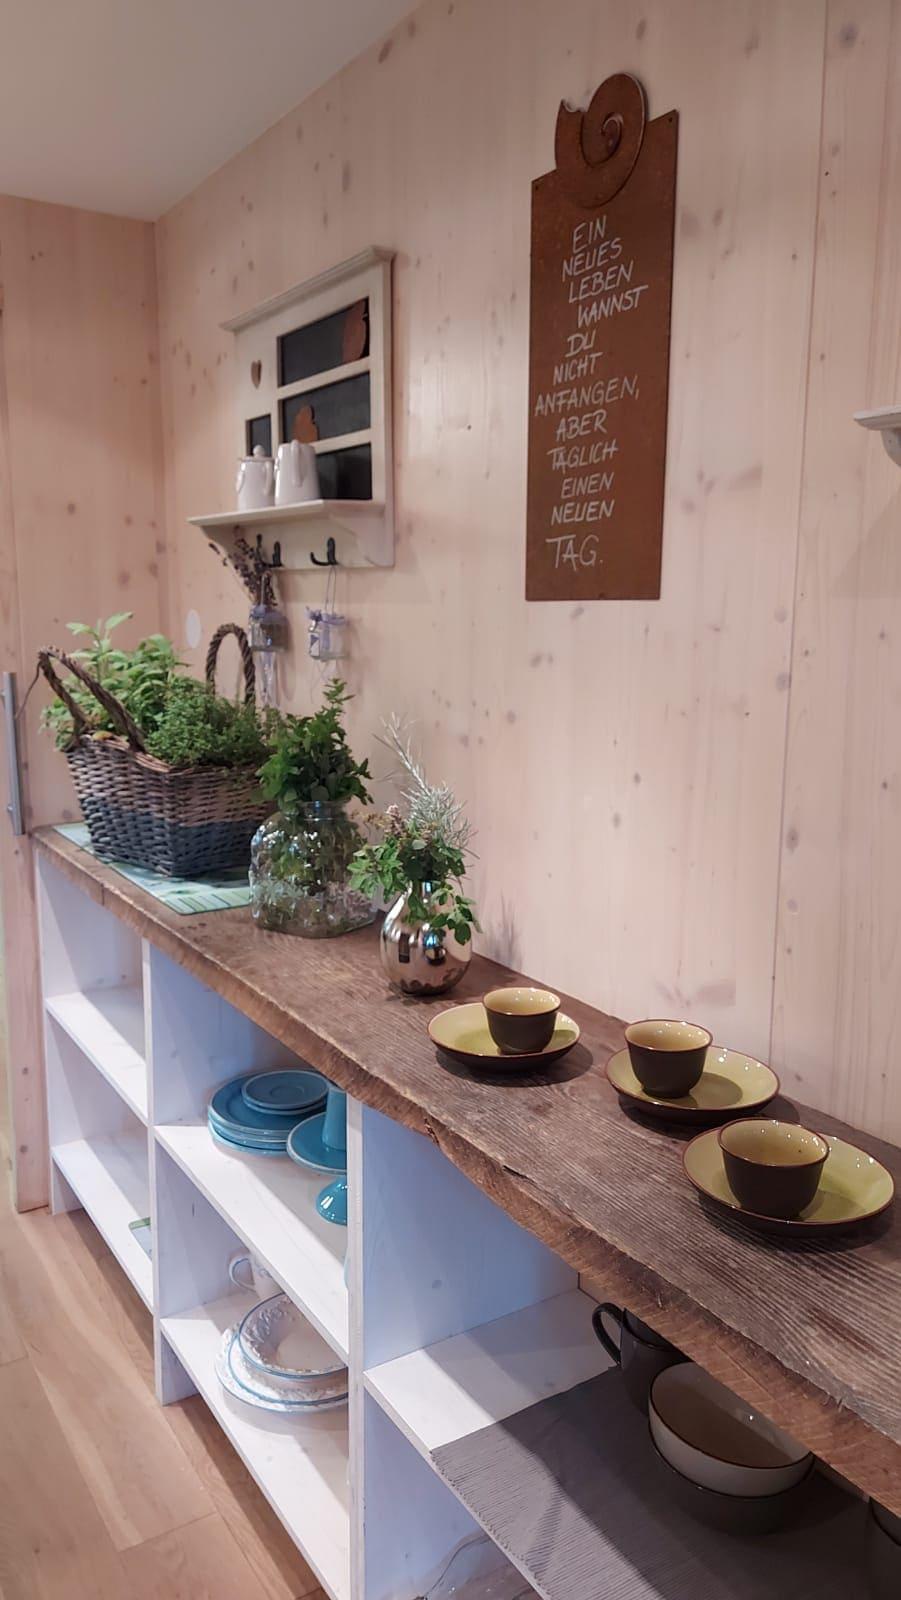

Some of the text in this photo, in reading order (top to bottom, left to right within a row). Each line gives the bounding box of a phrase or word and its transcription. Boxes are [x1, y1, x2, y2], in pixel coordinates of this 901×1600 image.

[572, 215, 607, 253] EIN
[562, 237, 623, 282] NEUES
[568, 260, 634, 304] LEBEN
[565, 330, 597, 358] DU
[553, 352, 603, 385] NICHT
[534, 374, 640, 417] ANFANGEN,
[556, 409, 608, 442] ABER
[560, 472, 615, 499] EINEN
[551, 499, 615, 526] NEUEN
[545, 534, 603, 571] TAG.
